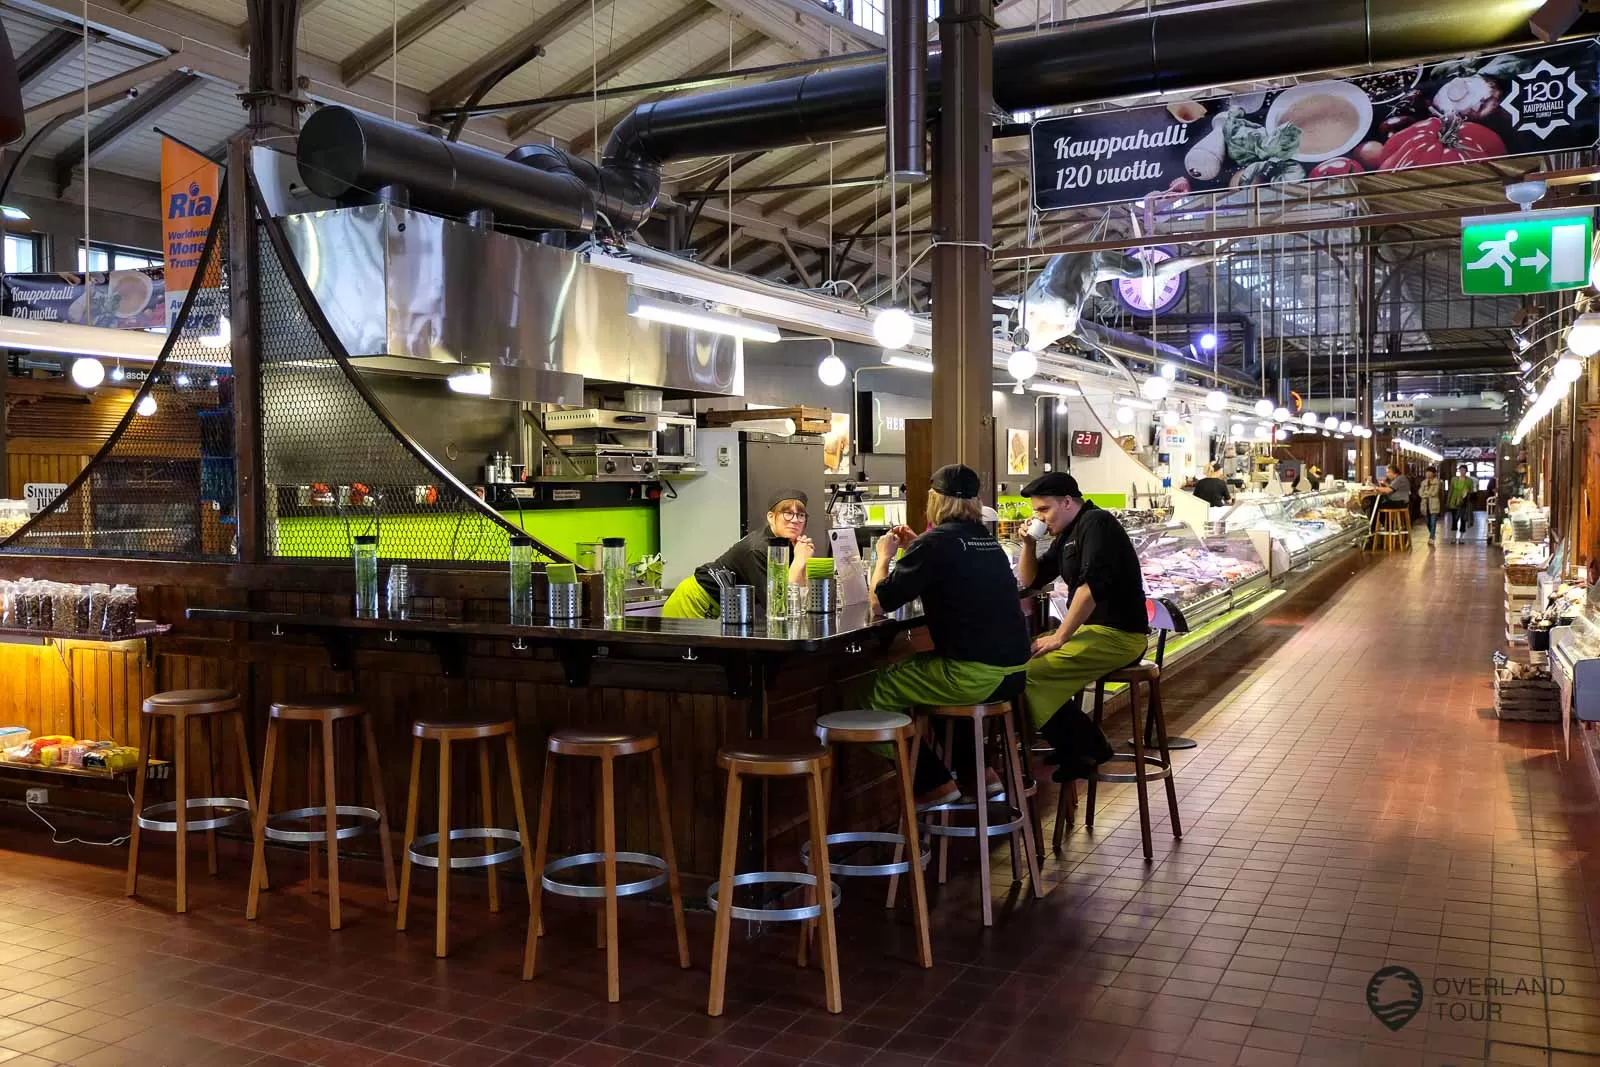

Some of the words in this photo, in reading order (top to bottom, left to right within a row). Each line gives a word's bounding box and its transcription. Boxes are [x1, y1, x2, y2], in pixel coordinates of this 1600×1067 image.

[1523, 80, 1564, 103] 120
[1523, 100, 1564, 114] KAUPPAHALLI
[1053, 123, 1189, 161] Kauppahalli
[1056, 164, 1092, 190] 120
[1096, 160, 1163, 185] vuotta
[168, 182, 212, 219] Ria
[168, 227, 209, 241] Worldwid
[169, 241, 205, 256] Mone
[169, 257, 200, 269] Trans
[11, 286, 74, 305] Kauppahalli
[12, 306, 28, 319] 120
[126, 371, 149, 380] asch
[1385, 409, 1415, 419] KALAA
[886, 416, 905, 431] HER
